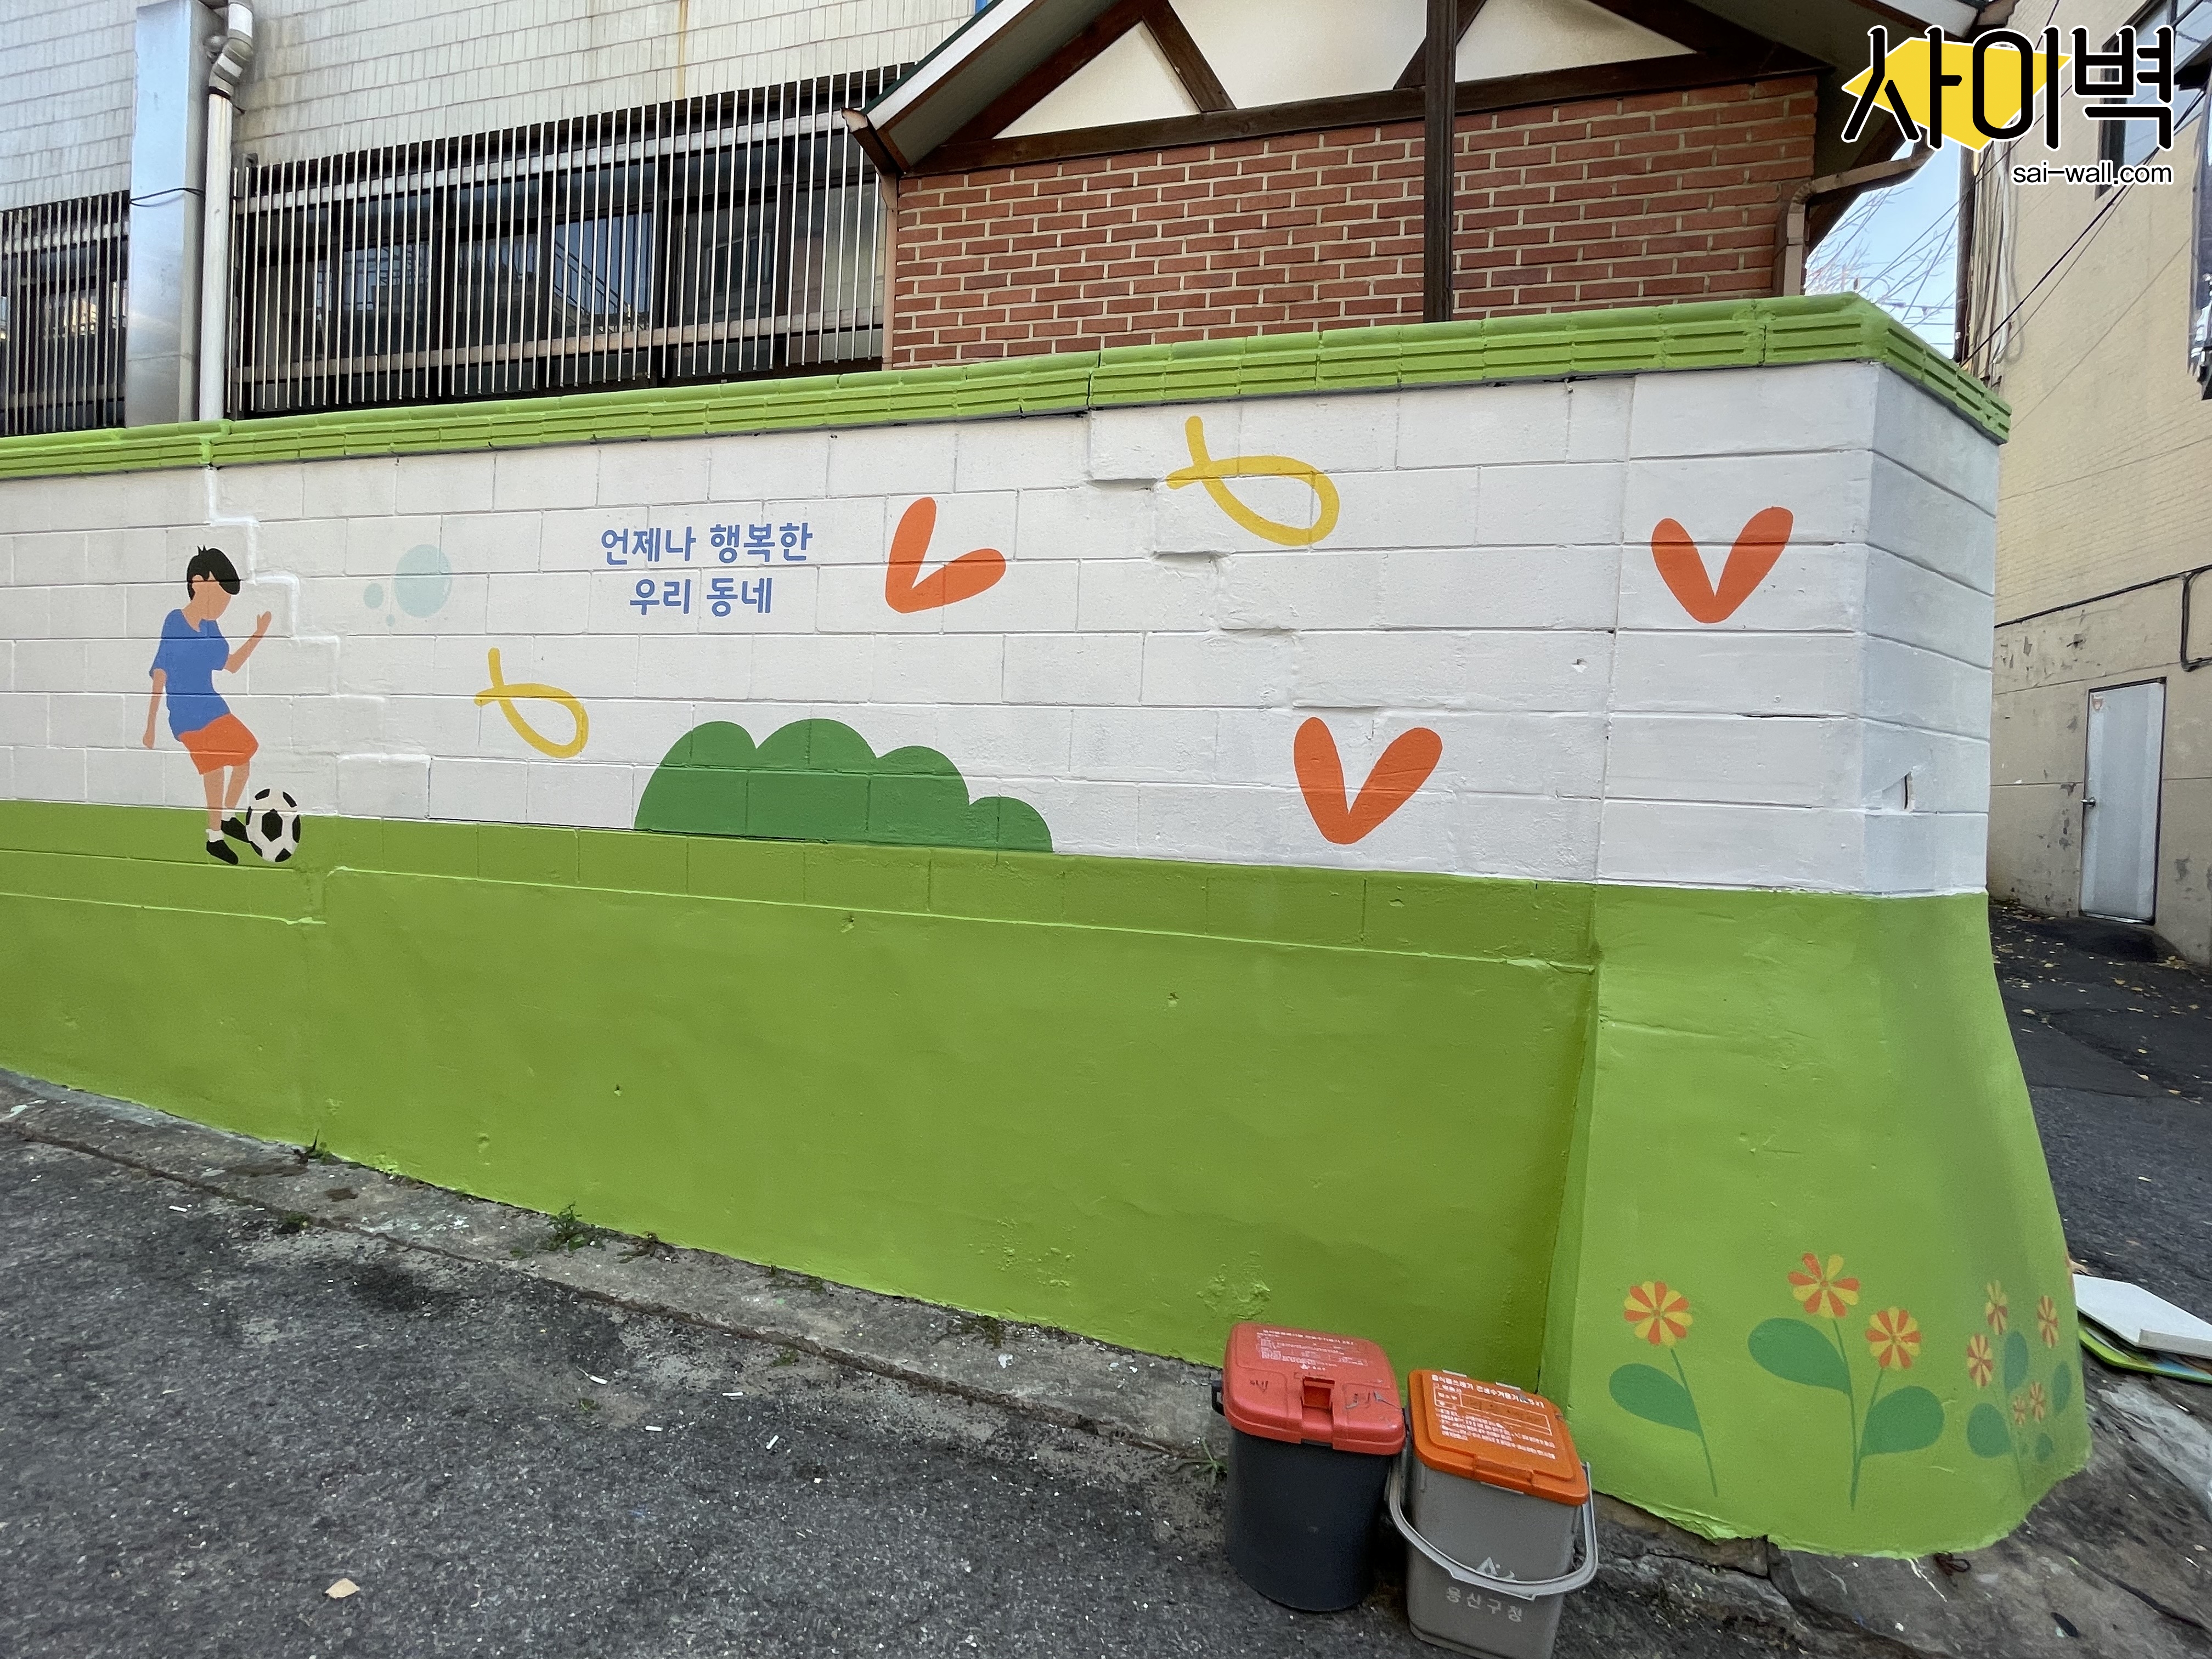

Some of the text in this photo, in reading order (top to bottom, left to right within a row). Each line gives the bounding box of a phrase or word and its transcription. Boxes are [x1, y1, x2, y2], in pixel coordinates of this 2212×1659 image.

[602, 523, 812, 565] 언제나 행복한
[630, 578, 772, 617] 우리 동네
[1447, 1587, 1523, 1623] 용산구청
